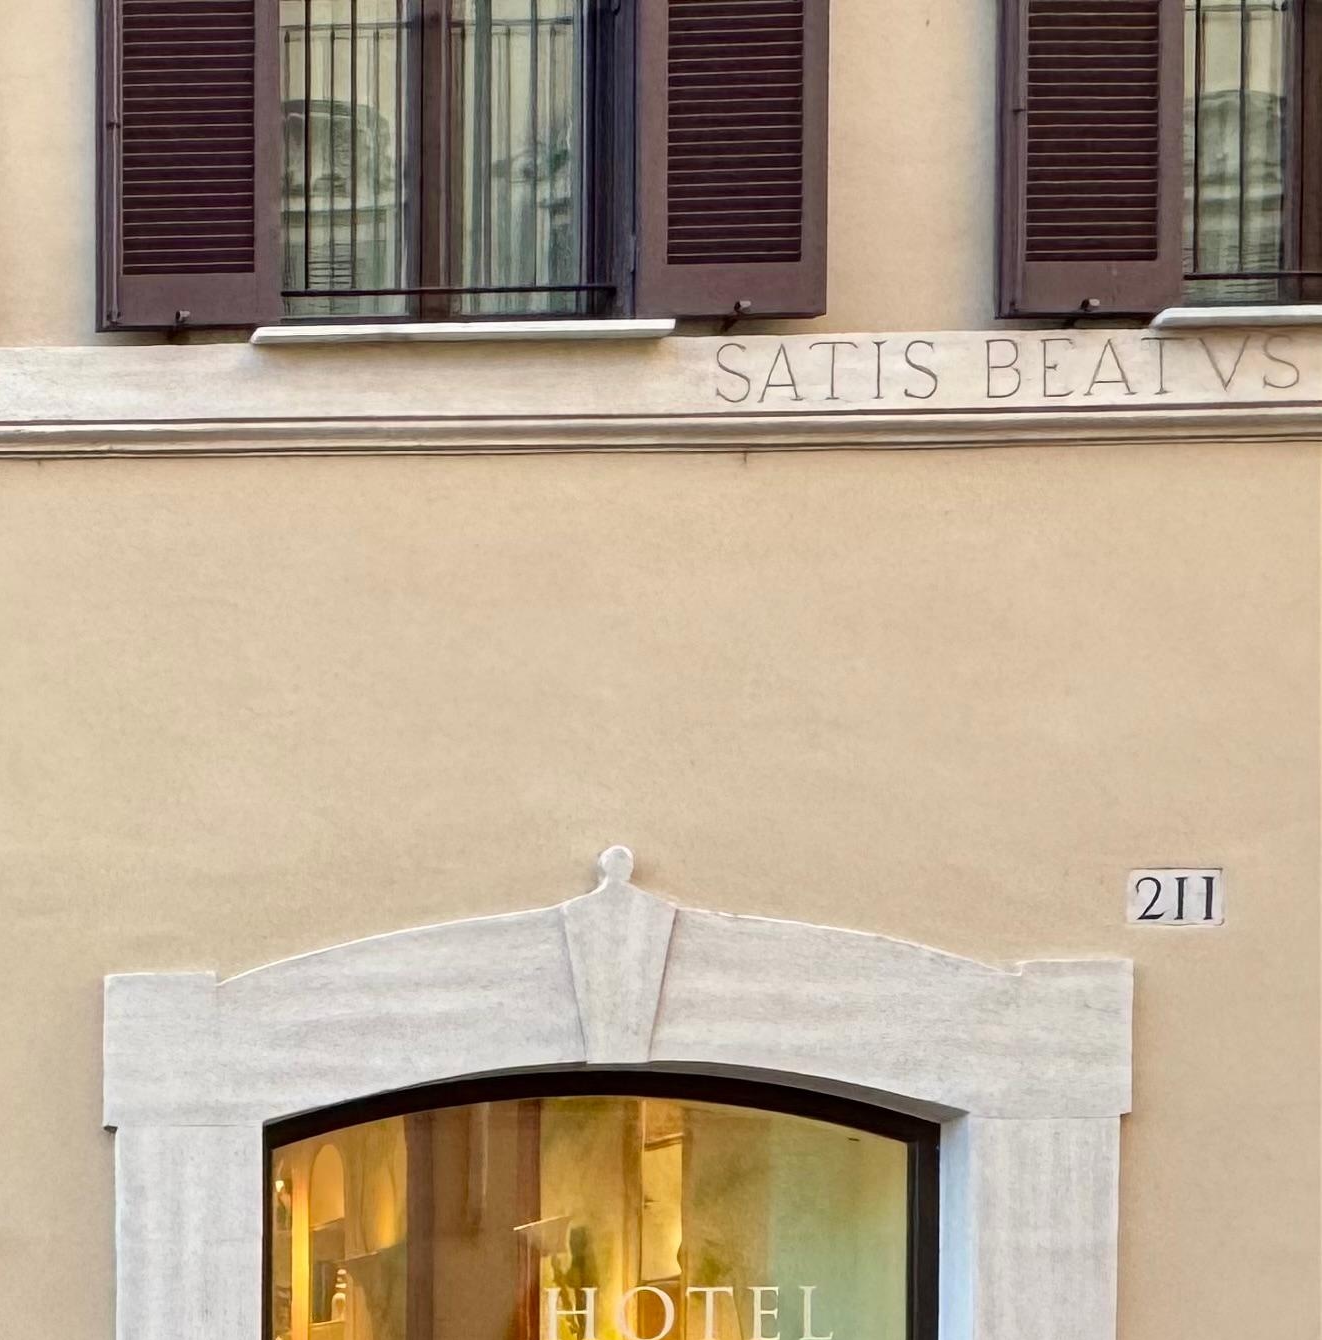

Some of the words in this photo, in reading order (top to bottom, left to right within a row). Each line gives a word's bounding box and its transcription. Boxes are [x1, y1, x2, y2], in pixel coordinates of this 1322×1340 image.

[715, 339, 939, 404] SATIS
[984, 334, 1301, 399] BEATVS
[1135, 876, 1216, 921] 211
